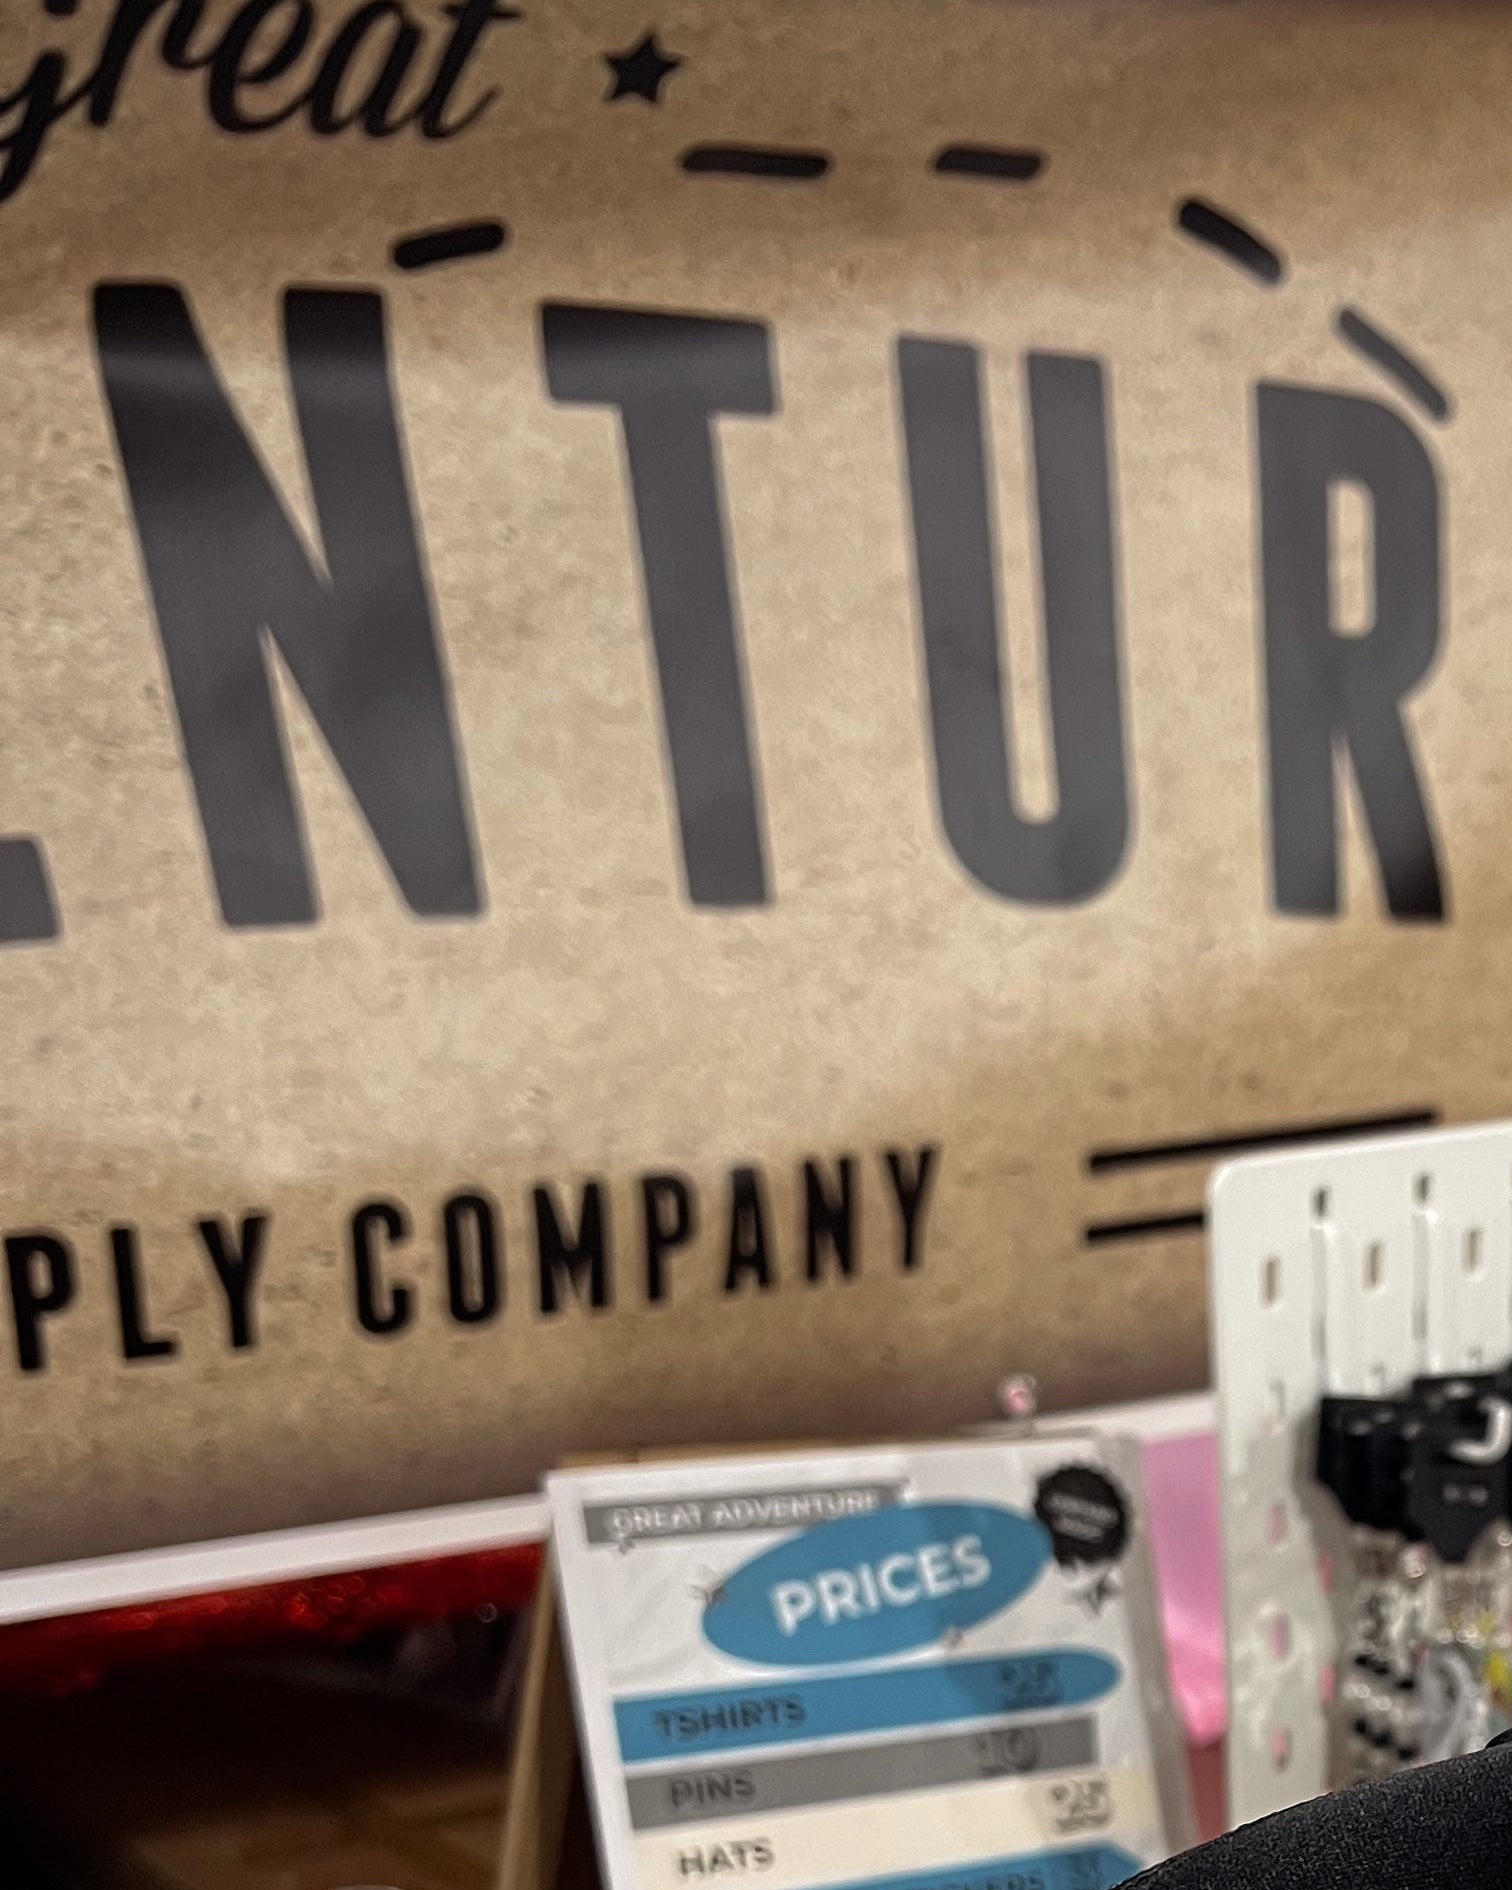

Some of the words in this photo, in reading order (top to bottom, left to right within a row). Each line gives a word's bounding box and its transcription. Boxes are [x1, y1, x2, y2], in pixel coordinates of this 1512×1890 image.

[352, 1146, 938, 1336] COMPANY
[611, 1501, 702, 1536] GREAT
[769, 1534, 993, 1637] PRICES
[655, 1698, 808, 1740] TSHIRTS
[670, 1769, 757, 1808] PINS
[678, 1838, 775, 1882] HATS
